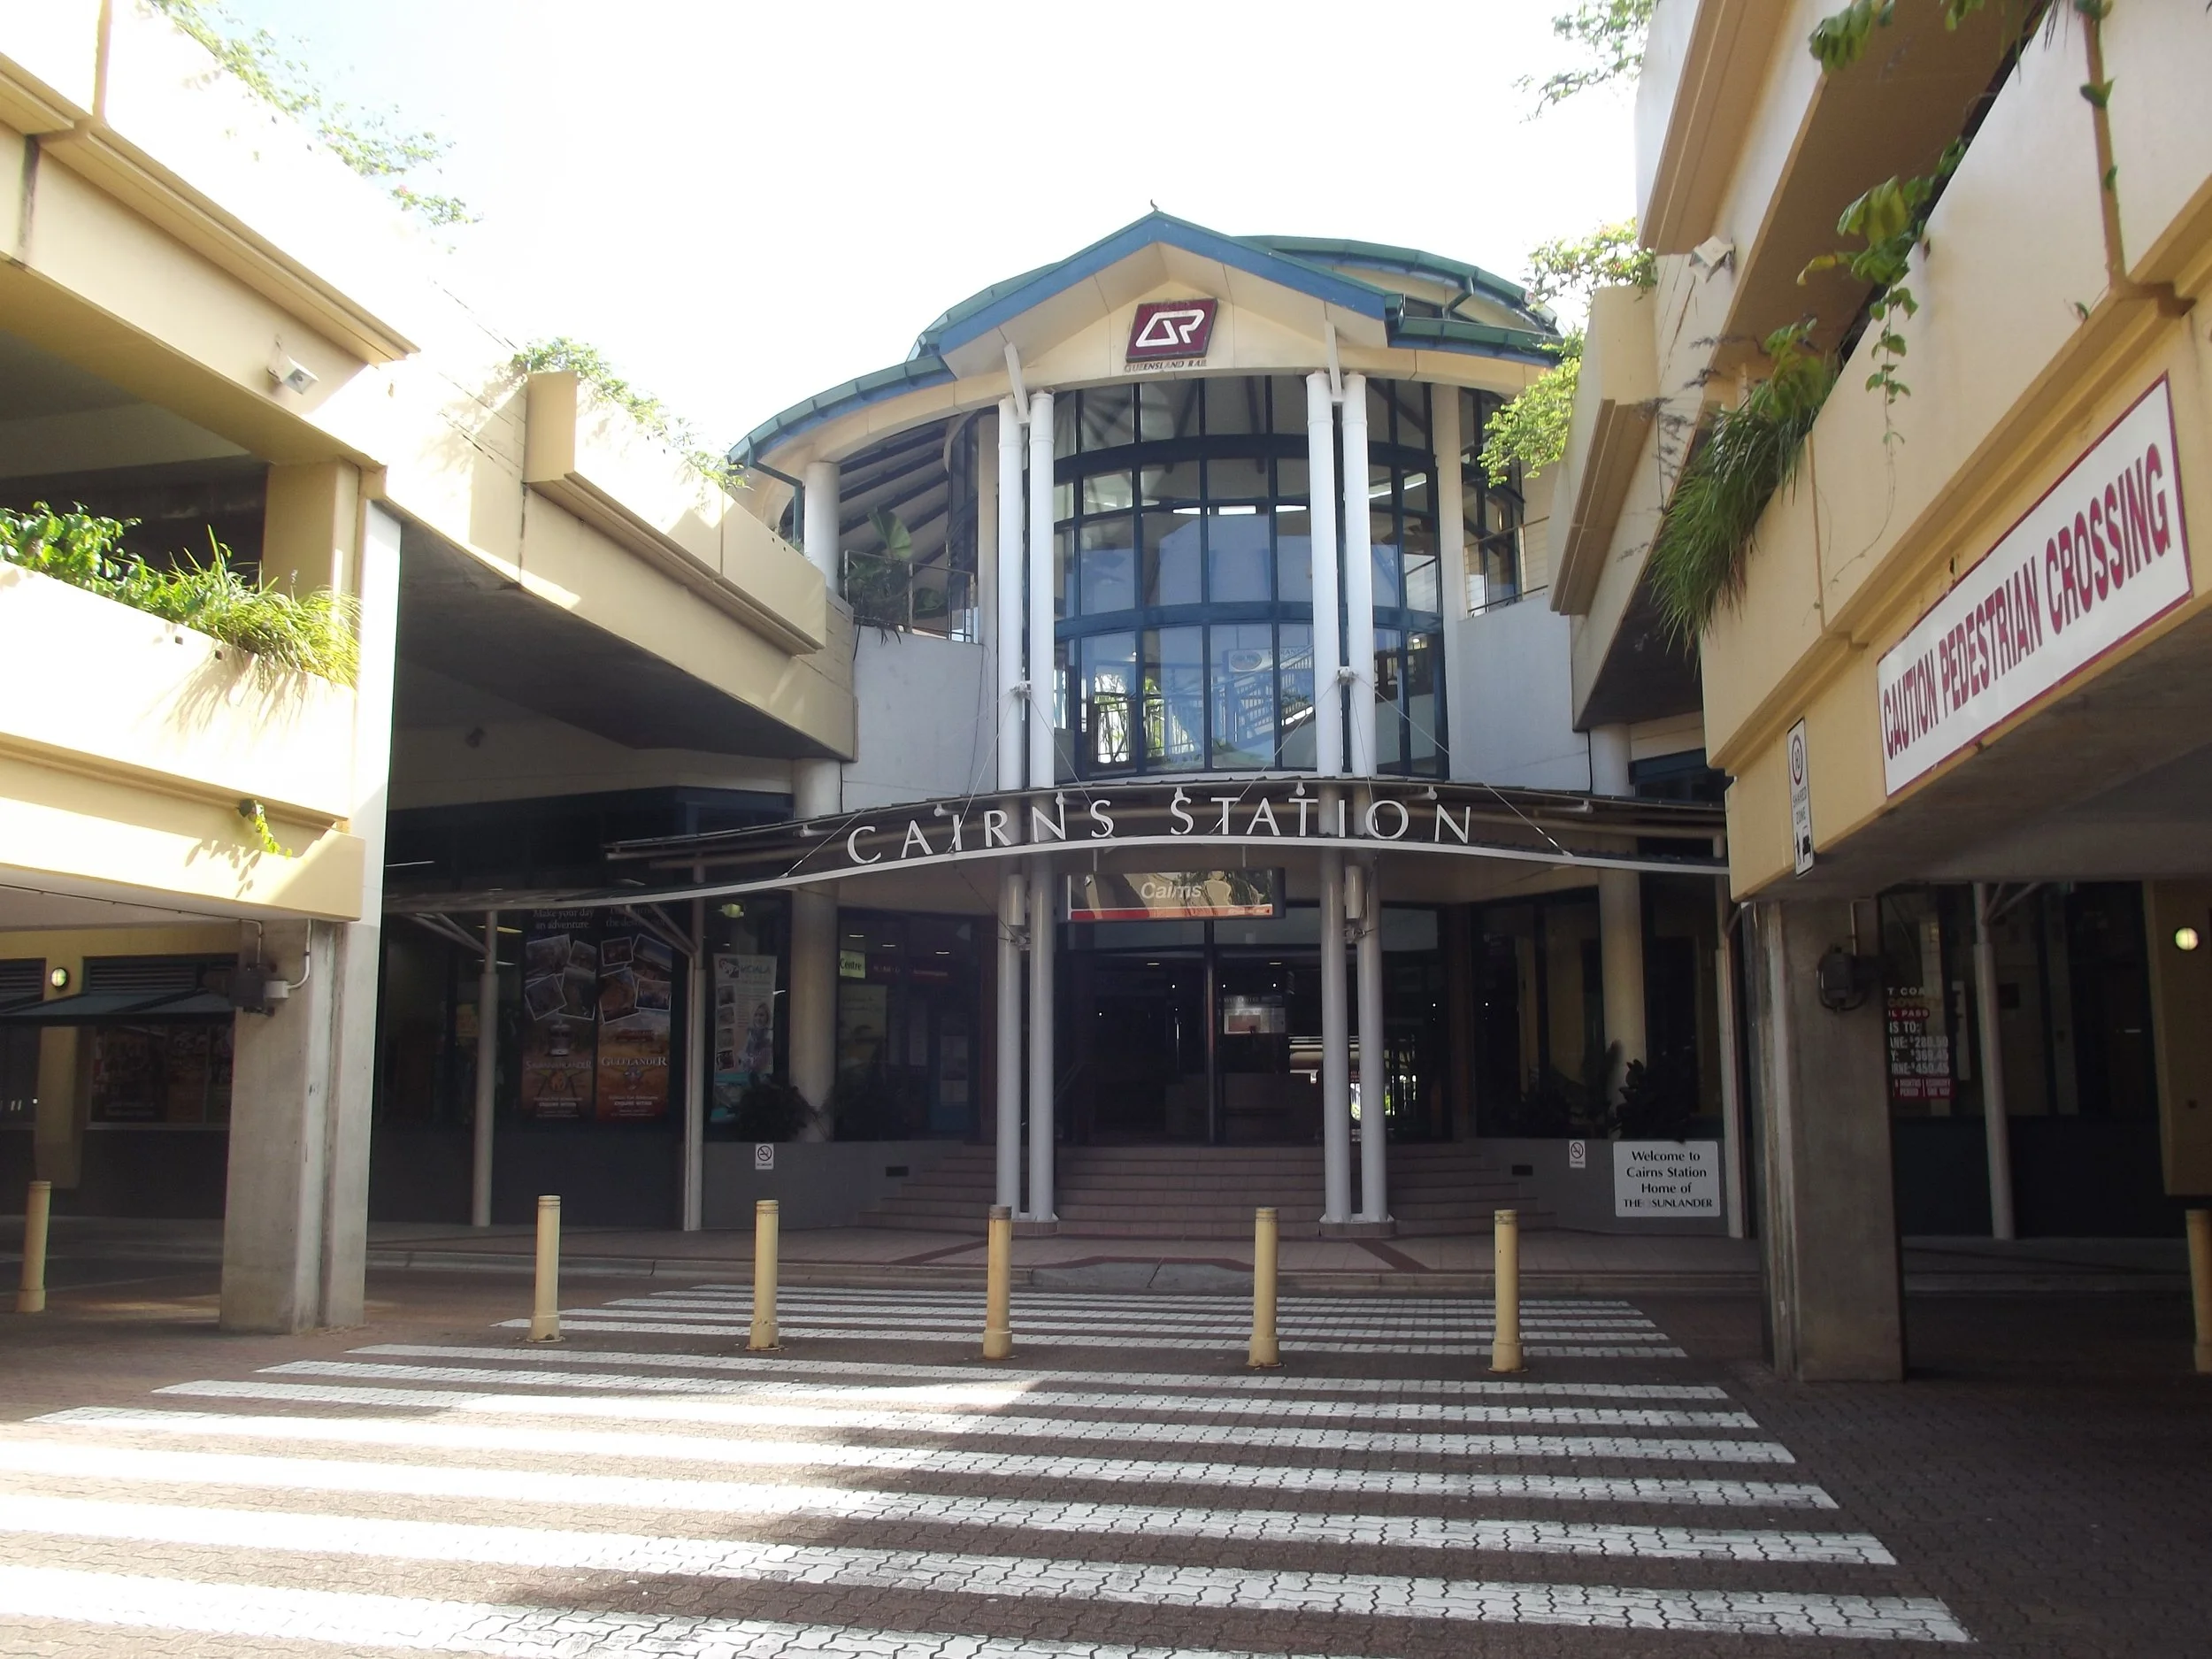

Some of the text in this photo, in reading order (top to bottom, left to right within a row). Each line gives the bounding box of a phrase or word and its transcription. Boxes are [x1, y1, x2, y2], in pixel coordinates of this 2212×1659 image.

[1884, 442, 2171, 760] CAUTION PEDESTRIAN CROSSING
[847, 796, 1471, 864] CAIRNS STATION
[1141, 881, 1202, 899] Cairns
[533, 908, 595, 919] Make your day
[840, 958, 863, 971] Centre
[601, 1056, 668, 1067] GULFLANDER
[1632, 1150, 1701, 1161] Welcome to
[1626, 1166, 1707, 1178] Cairns Station
[1641, 1182, 1692, 1194] Home of
[1624, 1198, 1713, 1208] THE SUNLANDER
